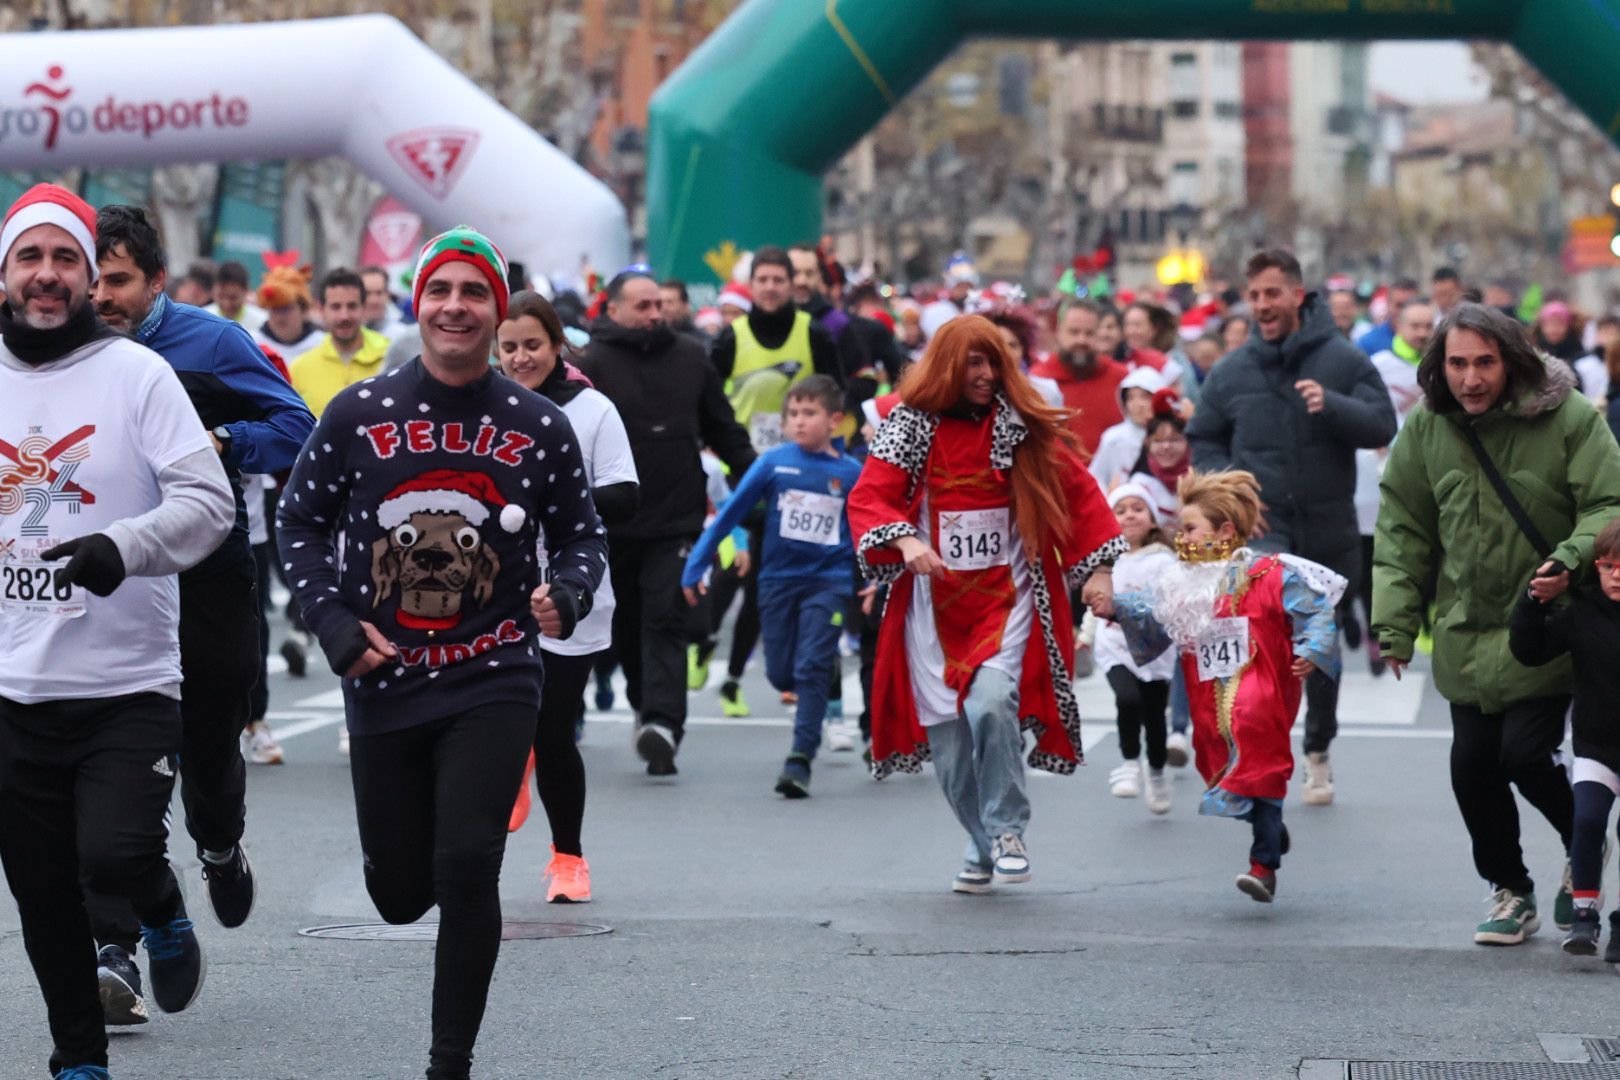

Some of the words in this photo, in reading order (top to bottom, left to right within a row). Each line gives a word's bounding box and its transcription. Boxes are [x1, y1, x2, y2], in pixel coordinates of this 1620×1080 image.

[93, 93, 249, 139] deporte
[366, 420, 535, 466] FELIZ
[788, 509, 835, 536] 5879
[949, 531, 1001, 559] 3143
